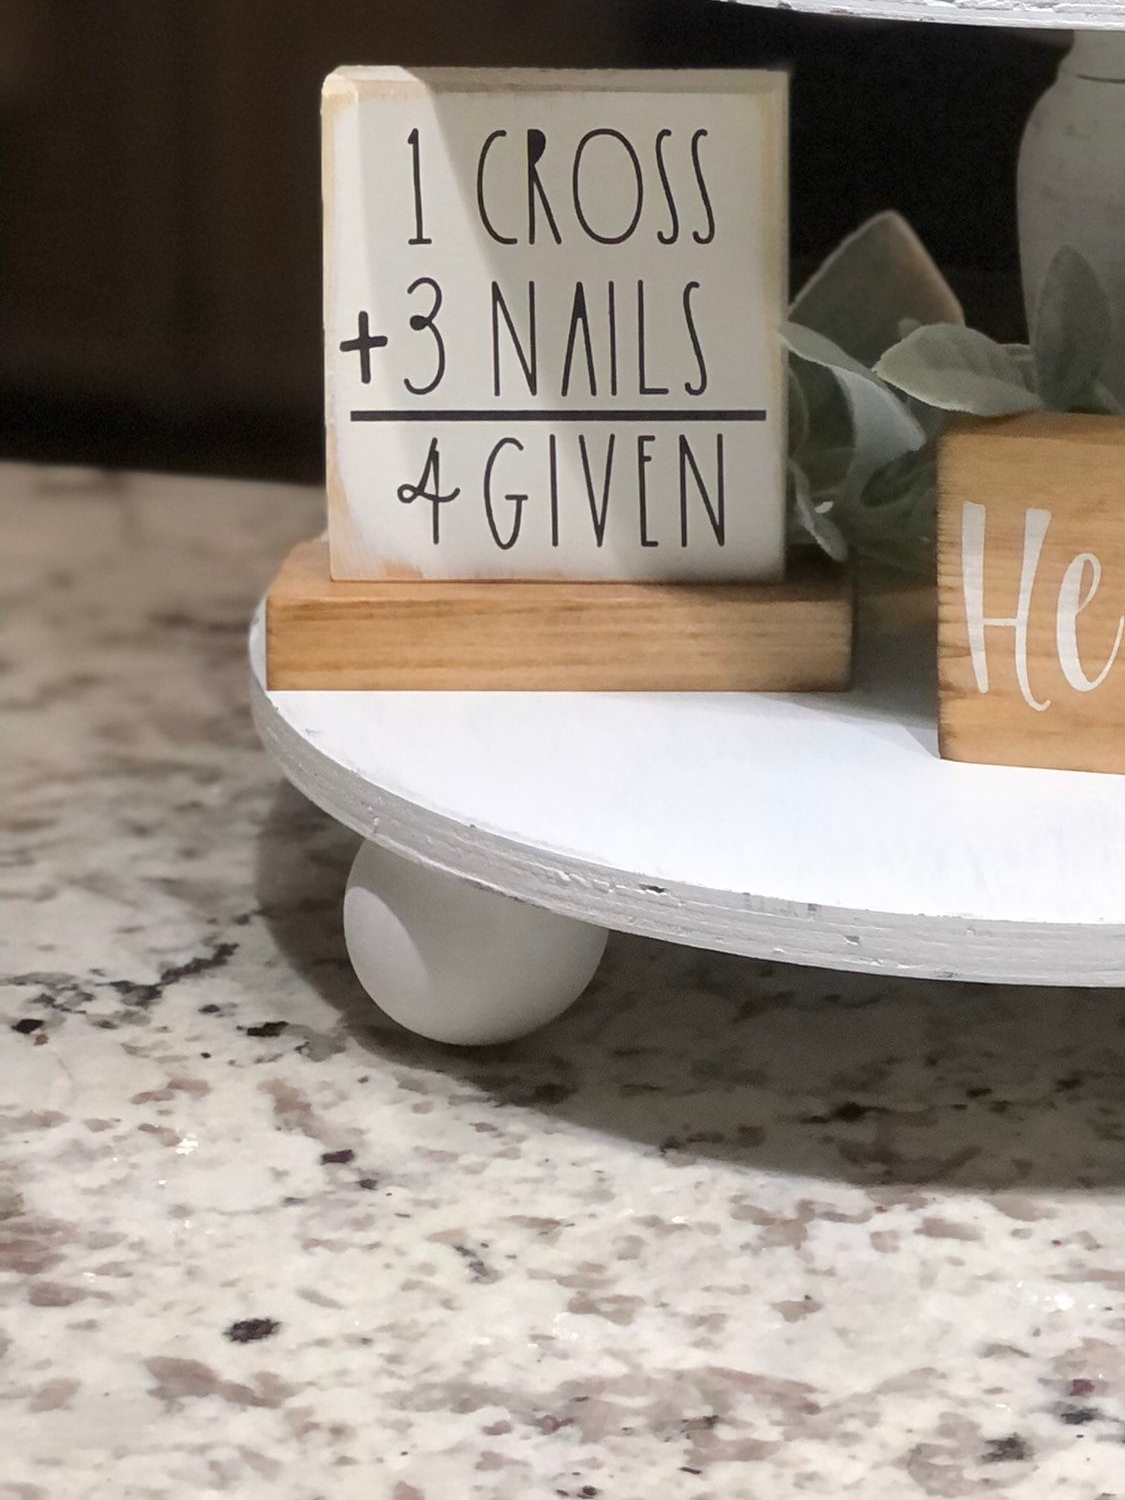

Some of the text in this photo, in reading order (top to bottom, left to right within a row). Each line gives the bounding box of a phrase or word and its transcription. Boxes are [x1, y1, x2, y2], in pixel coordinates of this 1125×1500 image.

[407, 128, 715, 245] 1 CROSS
[491, 280, 707, 396] NAILS
[396, 433, 725, 550] 4 GIVEN
[961, 500, 1125, 712] He
